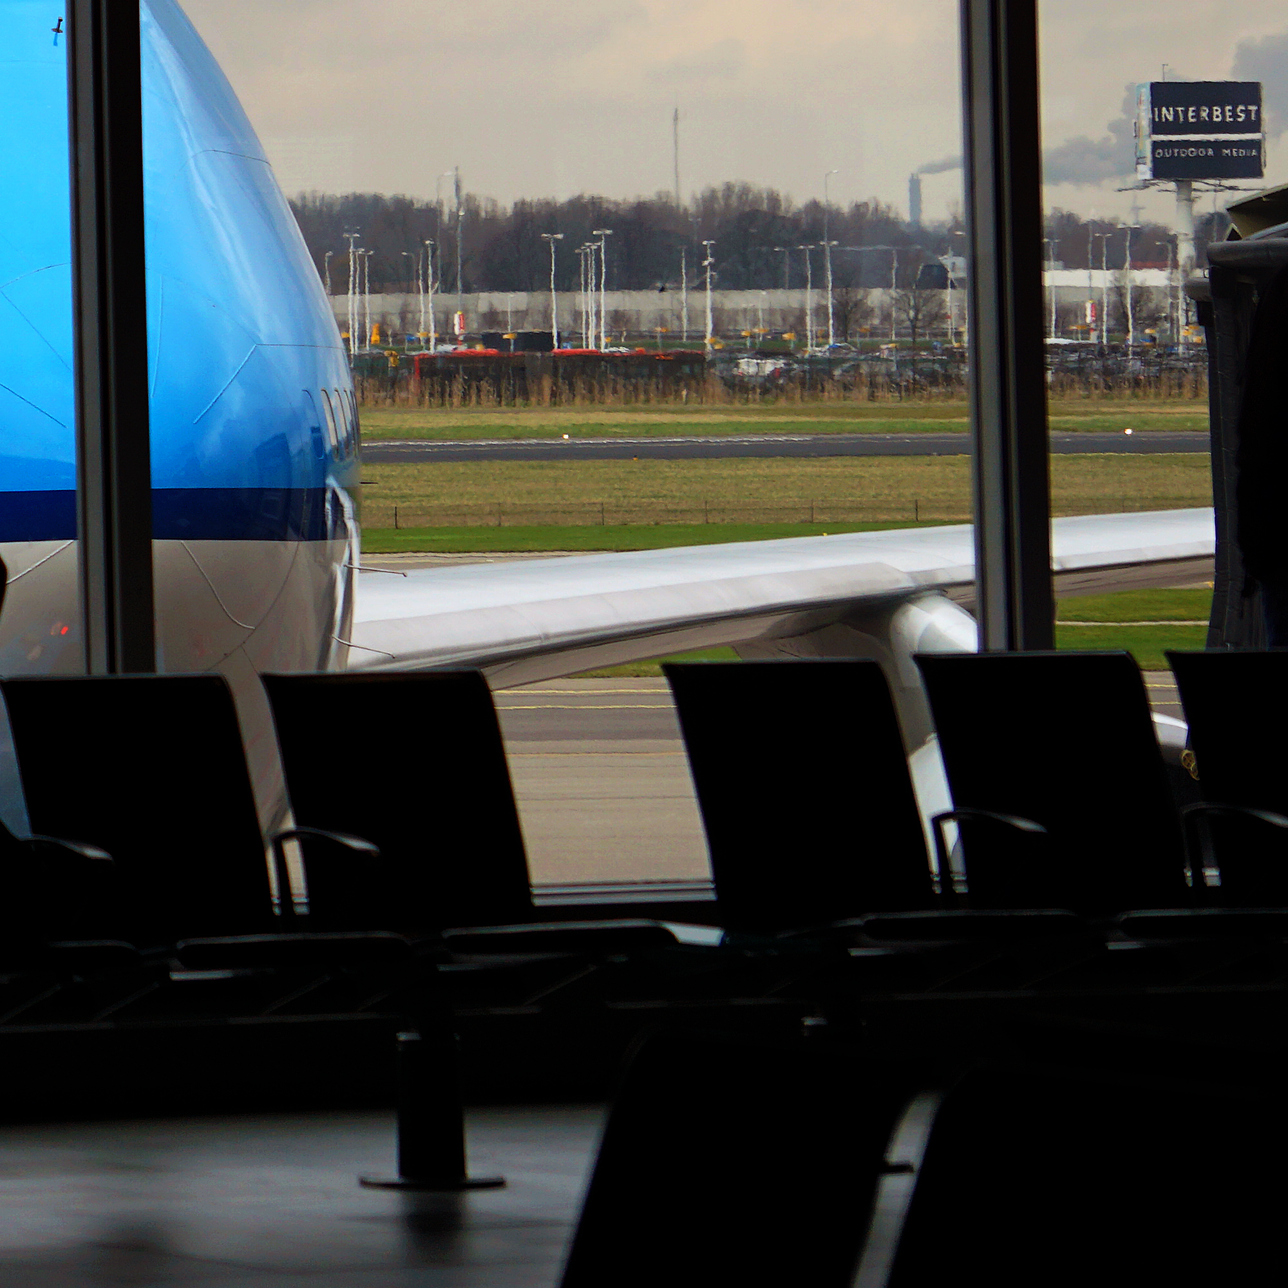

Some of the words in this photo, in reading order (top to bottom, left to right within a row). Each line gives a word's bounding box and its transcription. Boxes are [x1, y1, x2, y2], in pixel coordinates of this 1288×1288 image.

[1154, 105, 1258, 122] INTERBEST
[1155, 147, 1215, 158] OUTDOOR
[1221, 147, 1259, 158] MEDIA
